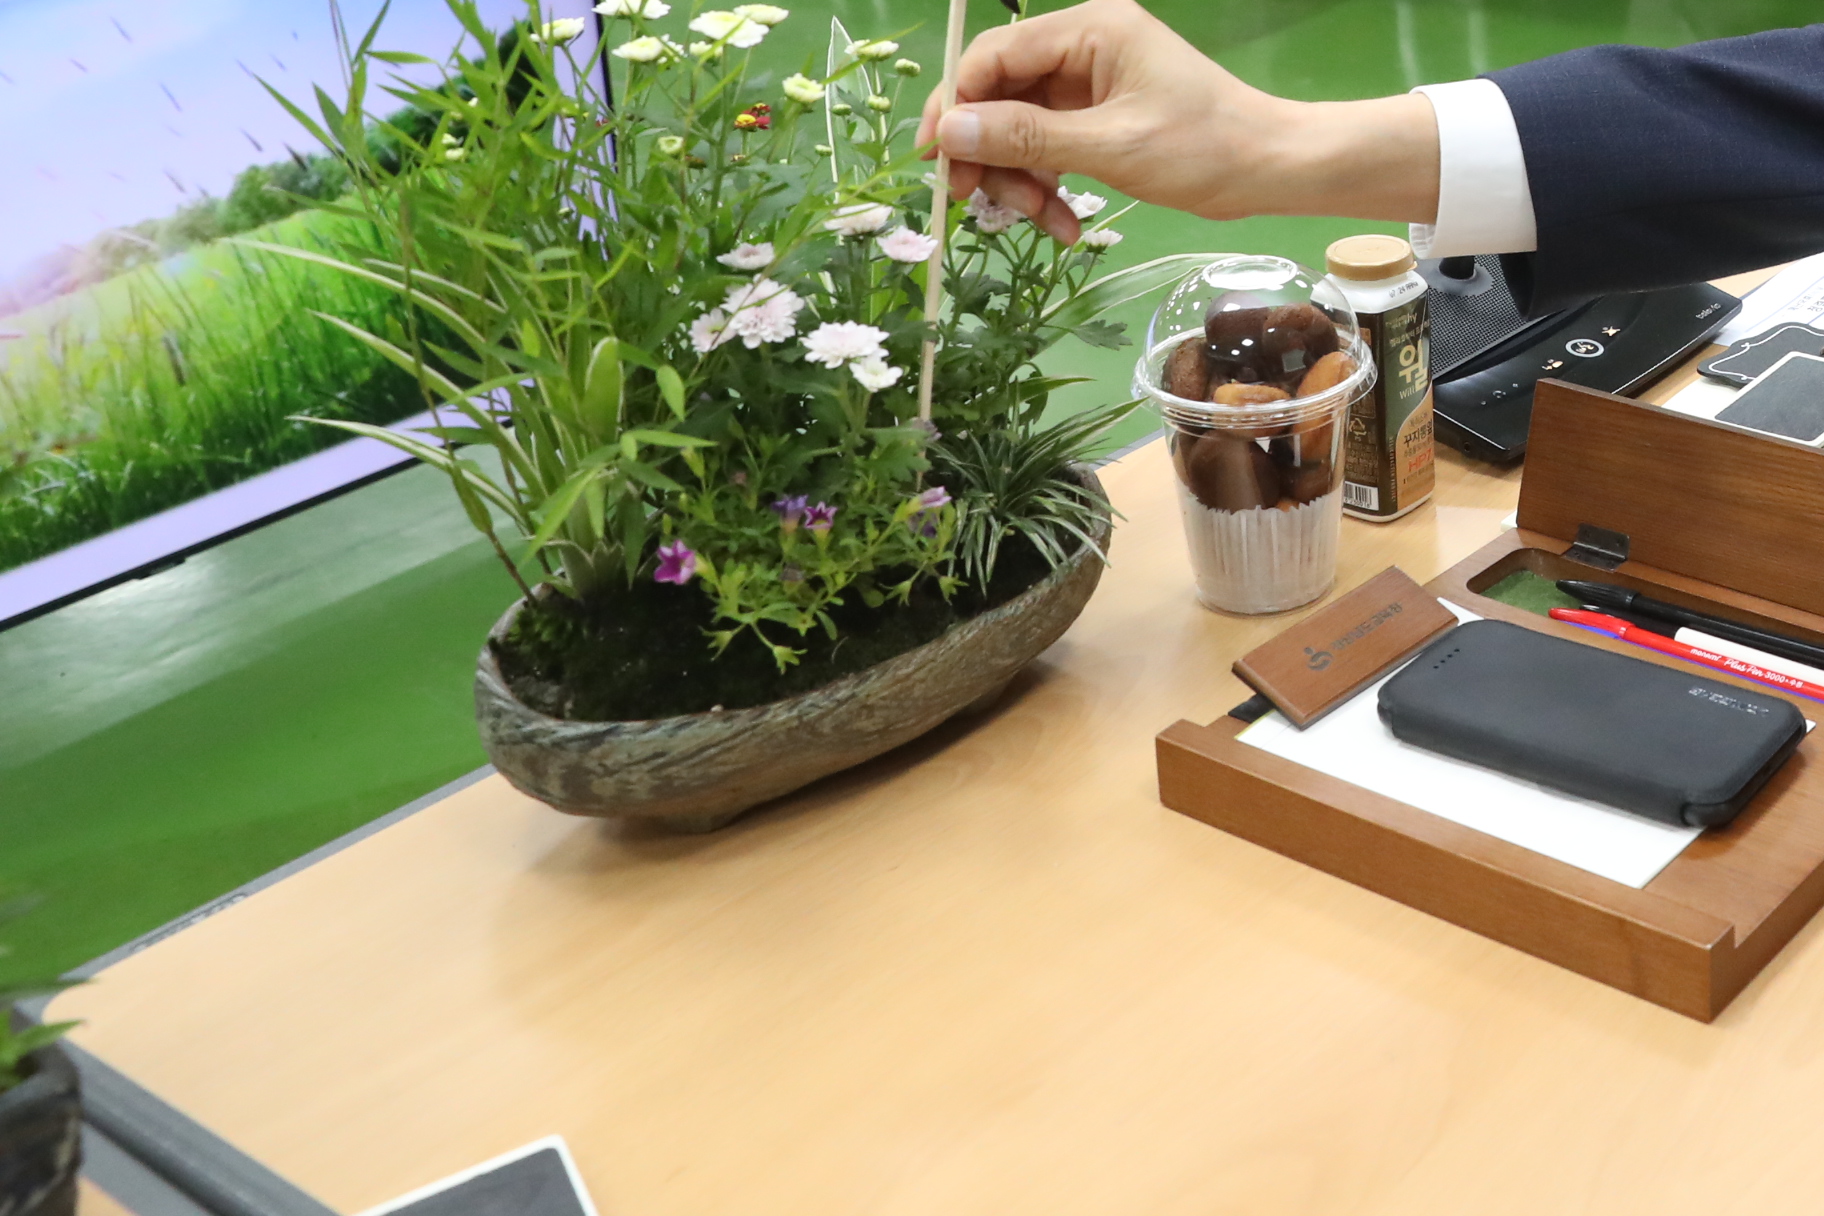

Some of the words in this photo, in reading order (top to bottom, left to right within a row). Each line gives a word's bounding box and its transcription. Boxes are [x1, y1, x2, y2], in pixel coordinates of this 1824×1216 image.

[1399, 384, 1416, 399] Will
[1724, 658, 1747, 672] Plus
[1746, 665, 1764, 677] Pen
